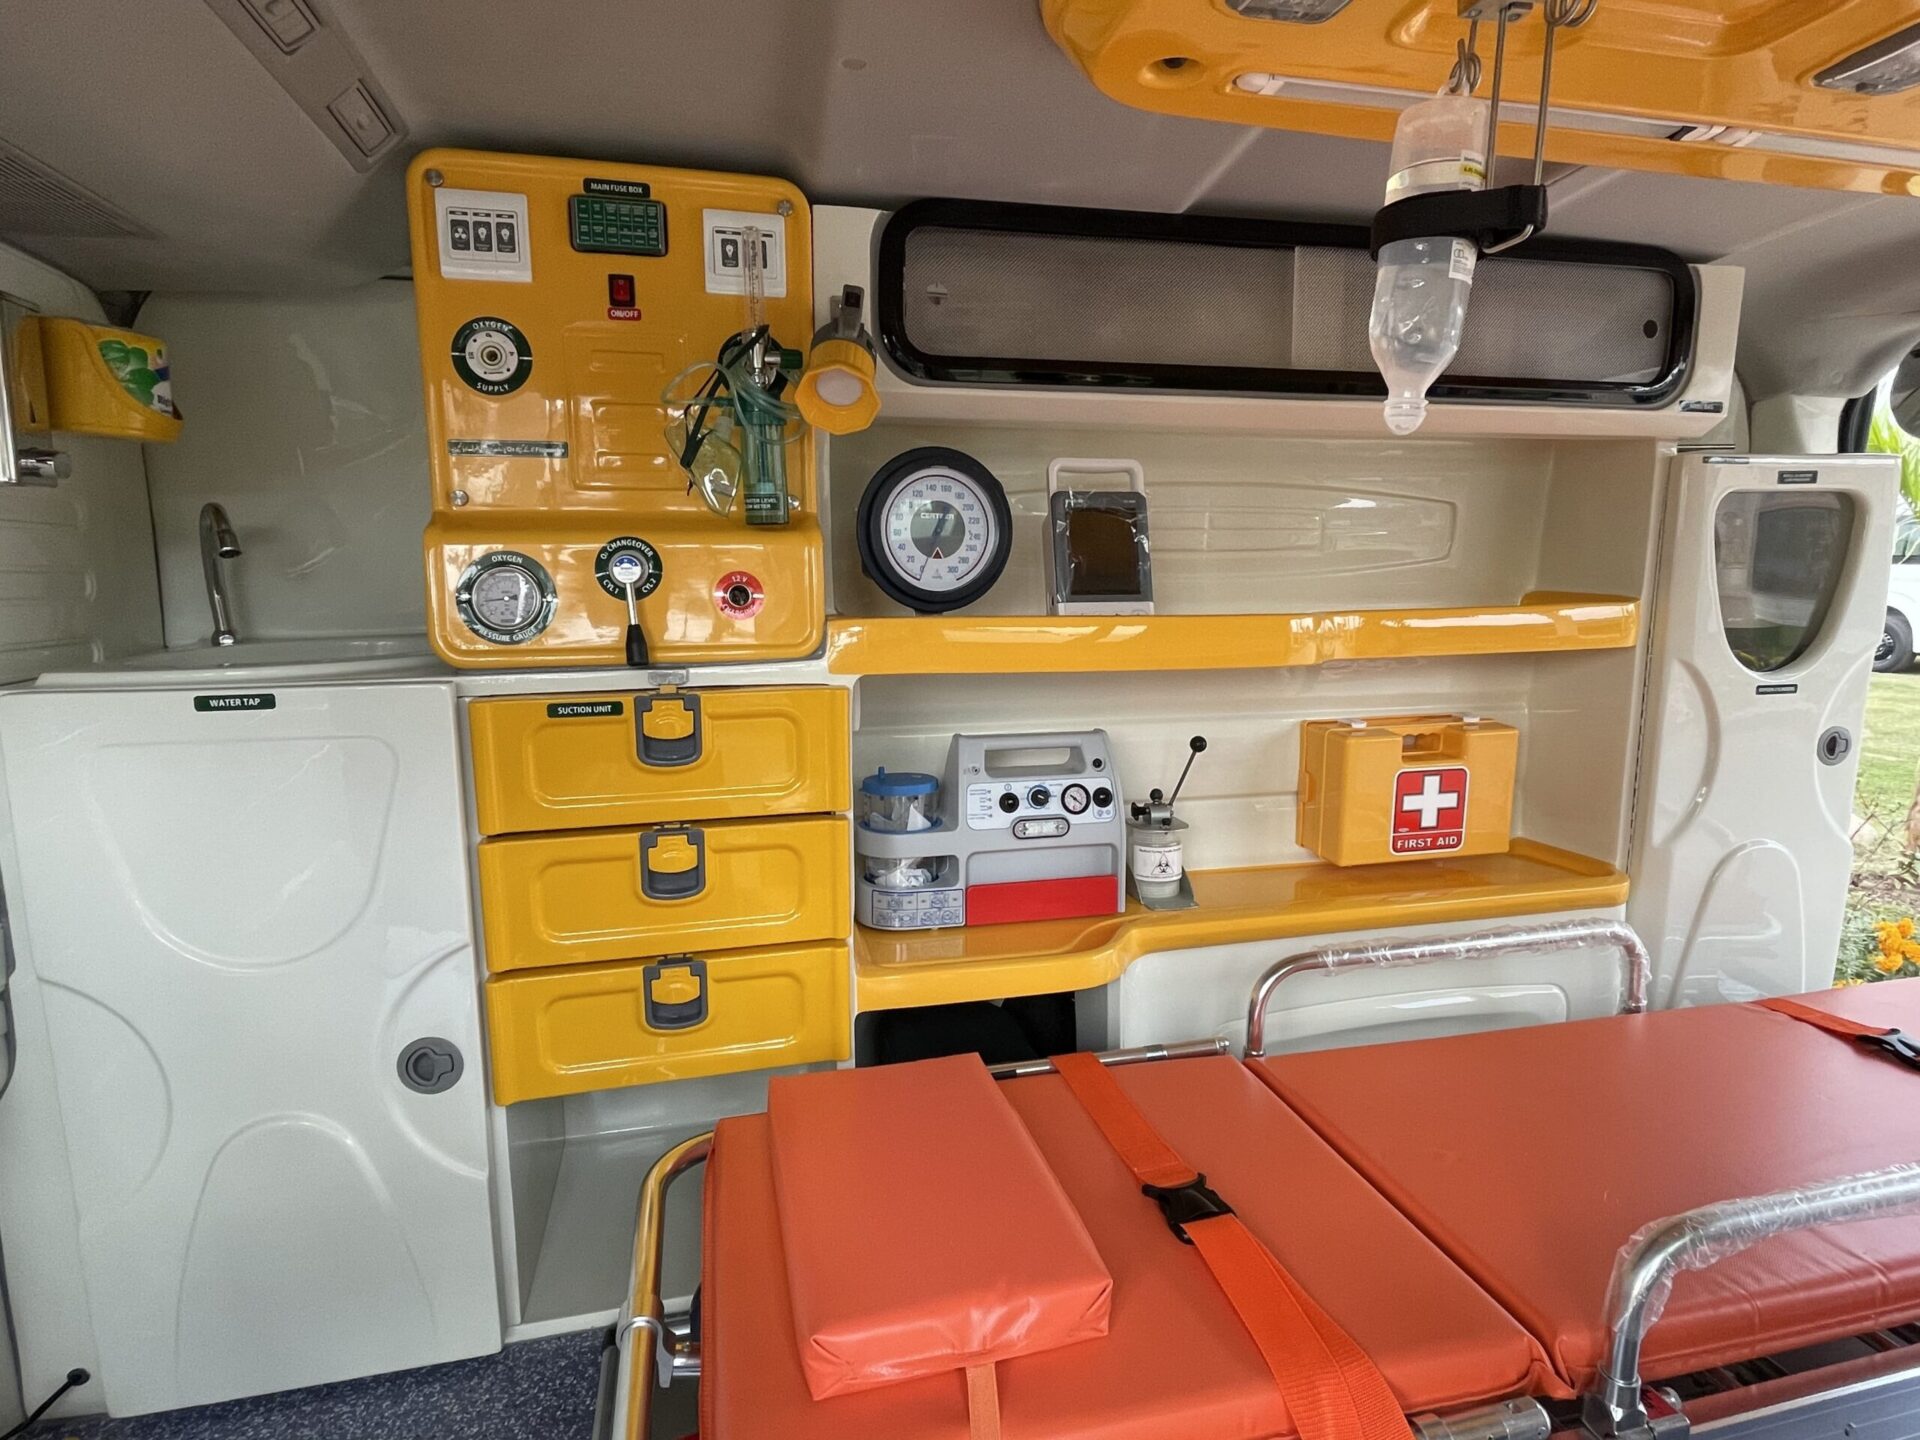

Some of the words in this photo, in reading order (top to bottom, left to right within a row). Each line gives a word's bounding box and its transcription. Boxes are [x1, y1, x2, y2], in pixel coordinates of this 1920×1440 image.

[590, 182, 610, 191] MAIN
[611, 183, 628, 192] FUSE
[628, 184, 643, 193] BOX
[610, 309, 638, 318] ON/OFF
[472, 320, 510, 332] OXYGEN
[476, 382, 509, 393] SUPPLY
[962, 503, 974, 511] 200
[606, 539, 654, 557] CHANGEOVER
[491, 554, 523, 564] OXYGEN
[906, 555, 915, 563] 20
[947, 566, 958, 574] 300
[603, 579, 614, 592] CYL
[512, 626, 537, 641] GAUGE
[209, 699, 241, 707] WATER
[243, 698, 261, 706] TAP
[557, 706, 592, 715] SUCTION
[593, 705, 612, 714] UNIT
[1397, 837, 1433, 849] FIRST
[1437, 836, 1458, 846] AID
